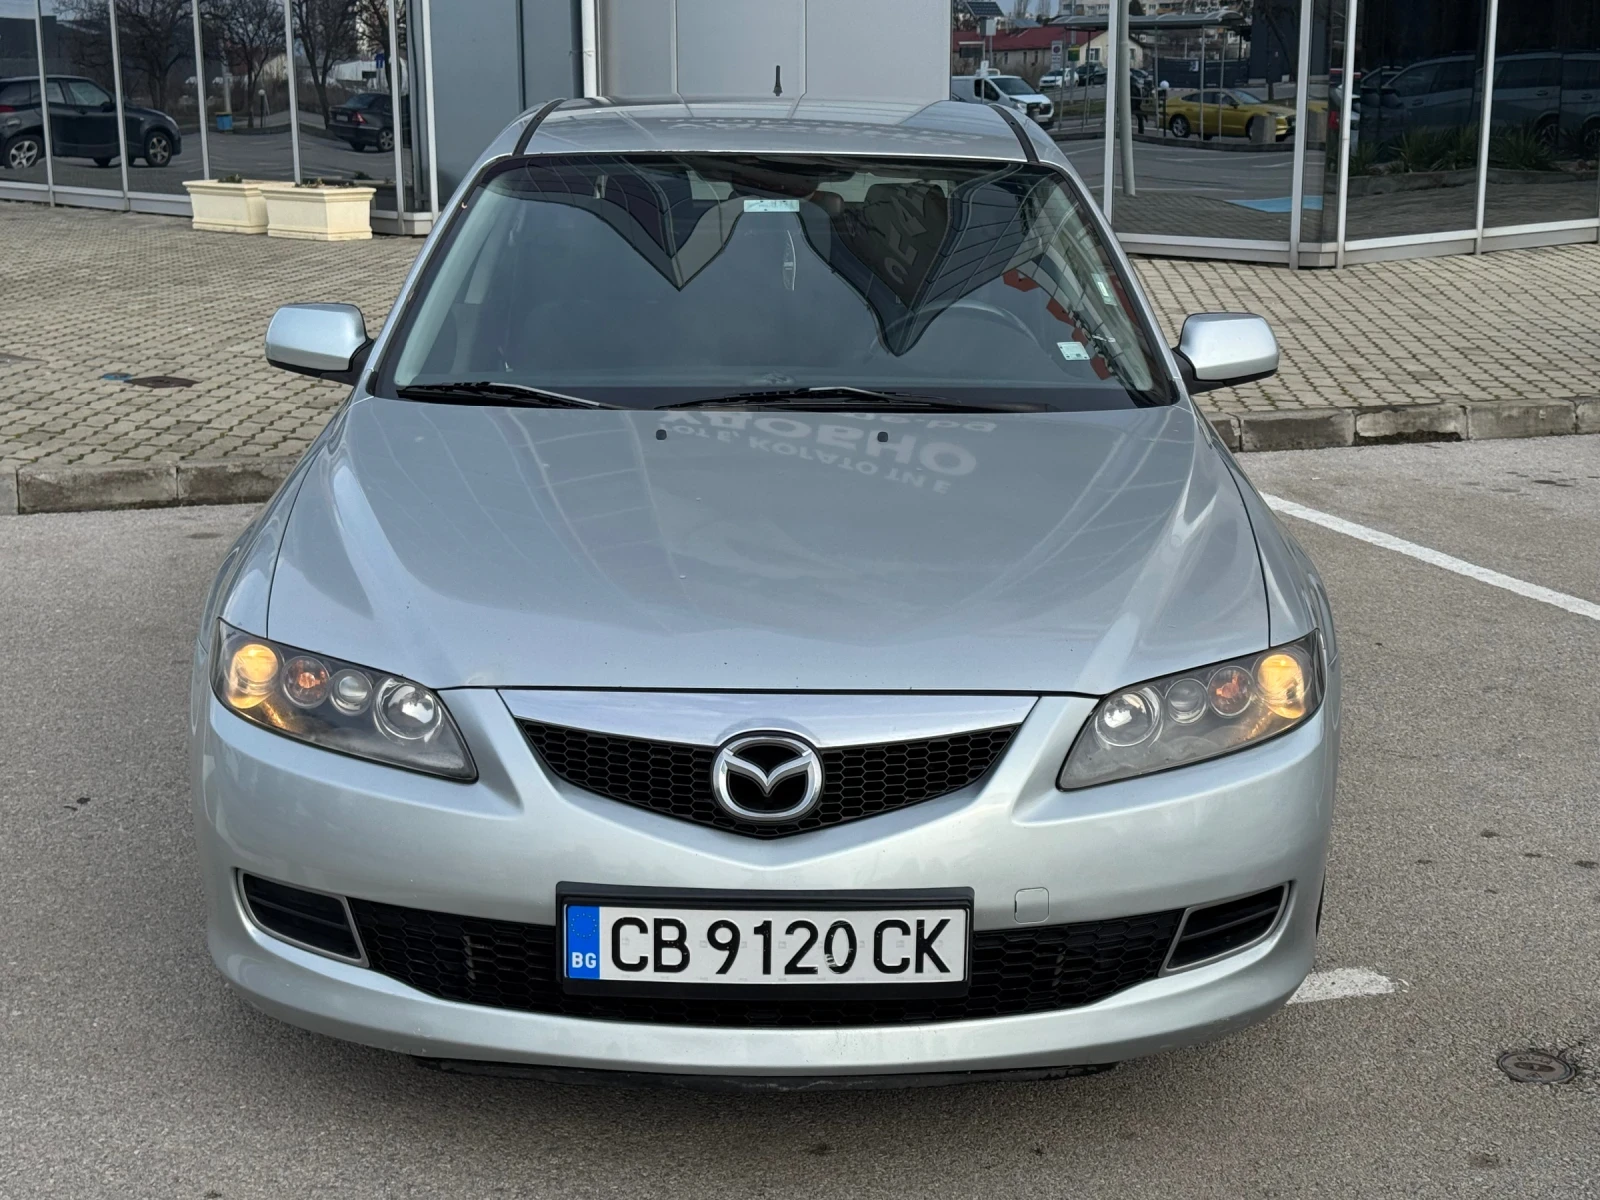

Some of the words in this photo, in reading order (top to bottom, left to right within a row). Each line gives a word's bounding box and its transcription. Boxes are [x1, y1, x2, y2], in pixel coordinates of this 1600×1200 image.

[571, 952, 597, 968] BG
[611, 916, 691, 973] CB
[707, 919, 857, 975] 9120
[873, 918, 951, 974] CK
